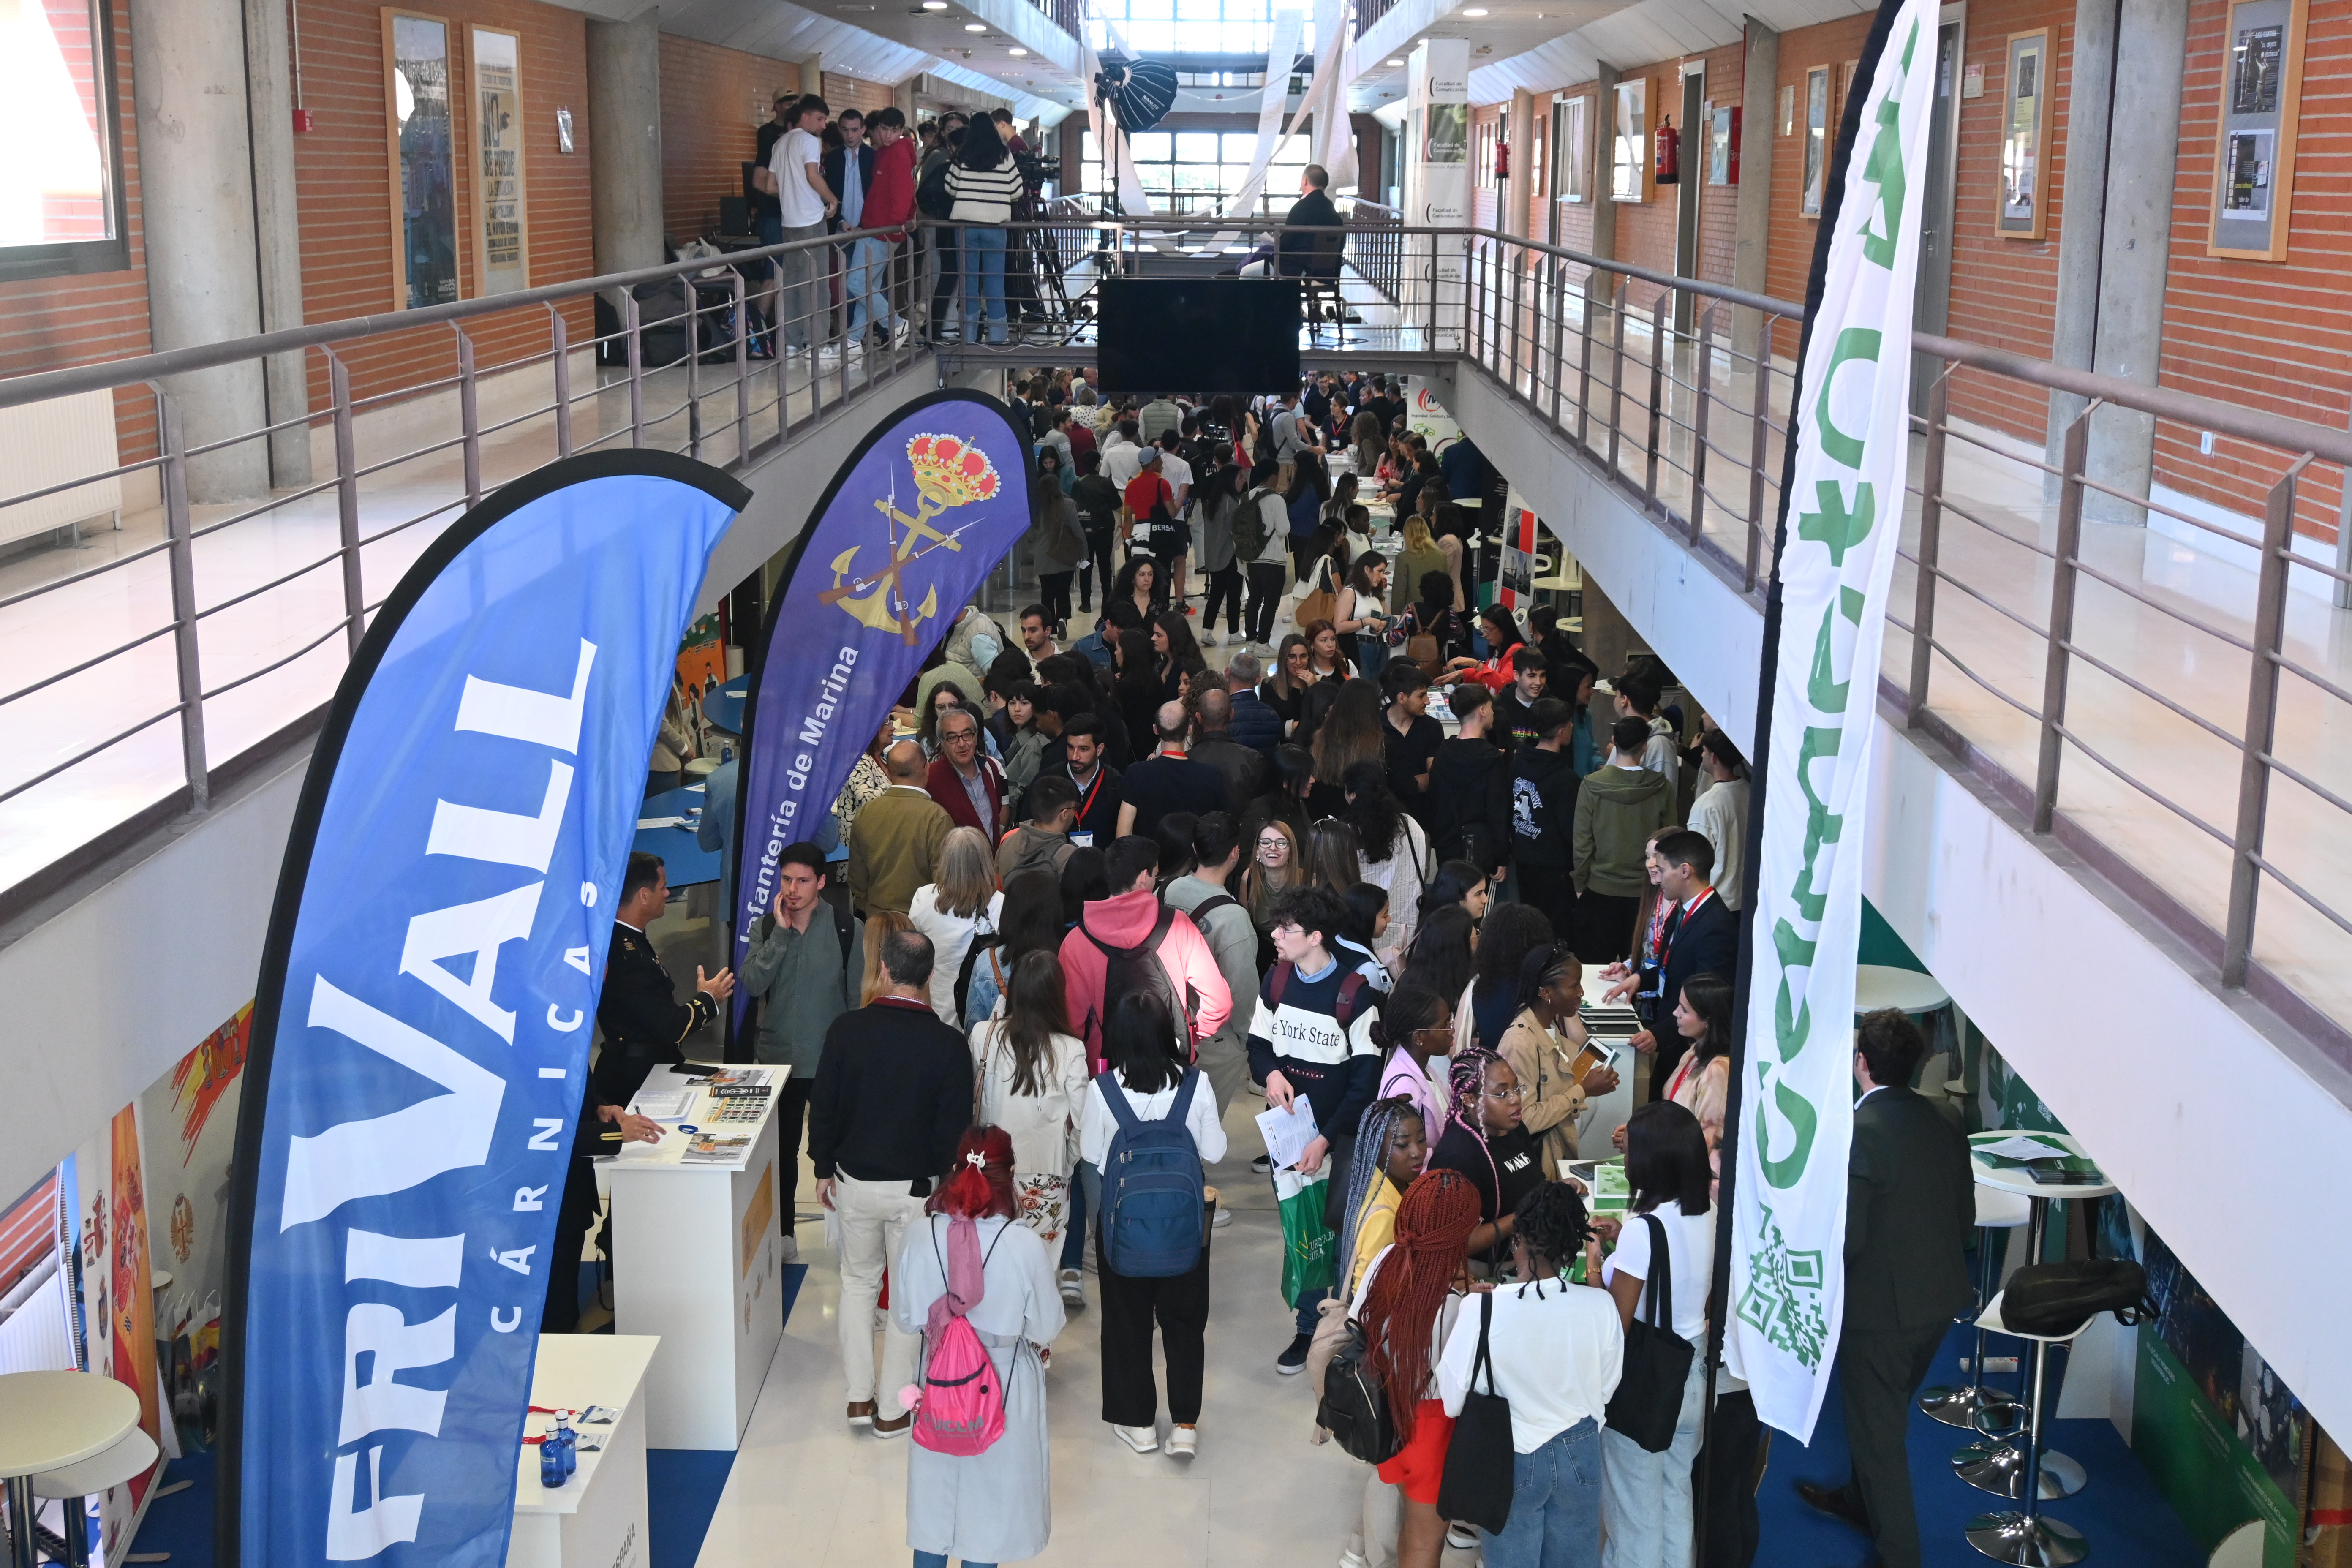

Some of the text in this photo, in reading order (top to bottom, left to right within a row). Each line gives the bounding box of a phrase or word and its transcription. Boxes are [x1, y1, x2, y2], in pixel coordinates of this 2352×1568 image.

[482, 91, 500, 147] NO
[1143, 95, 1160, 110] NANLITE
[799, 646, 859, 746] Marina
[787, 754, 813, 791] de
[1279, 1019, 1307, 1041] York
[1309, 1027, 1340, 1047] State
[280, 637, 598, 1562] FRIVALL
[490, 881, 597, 1334] CÁRNICAS
